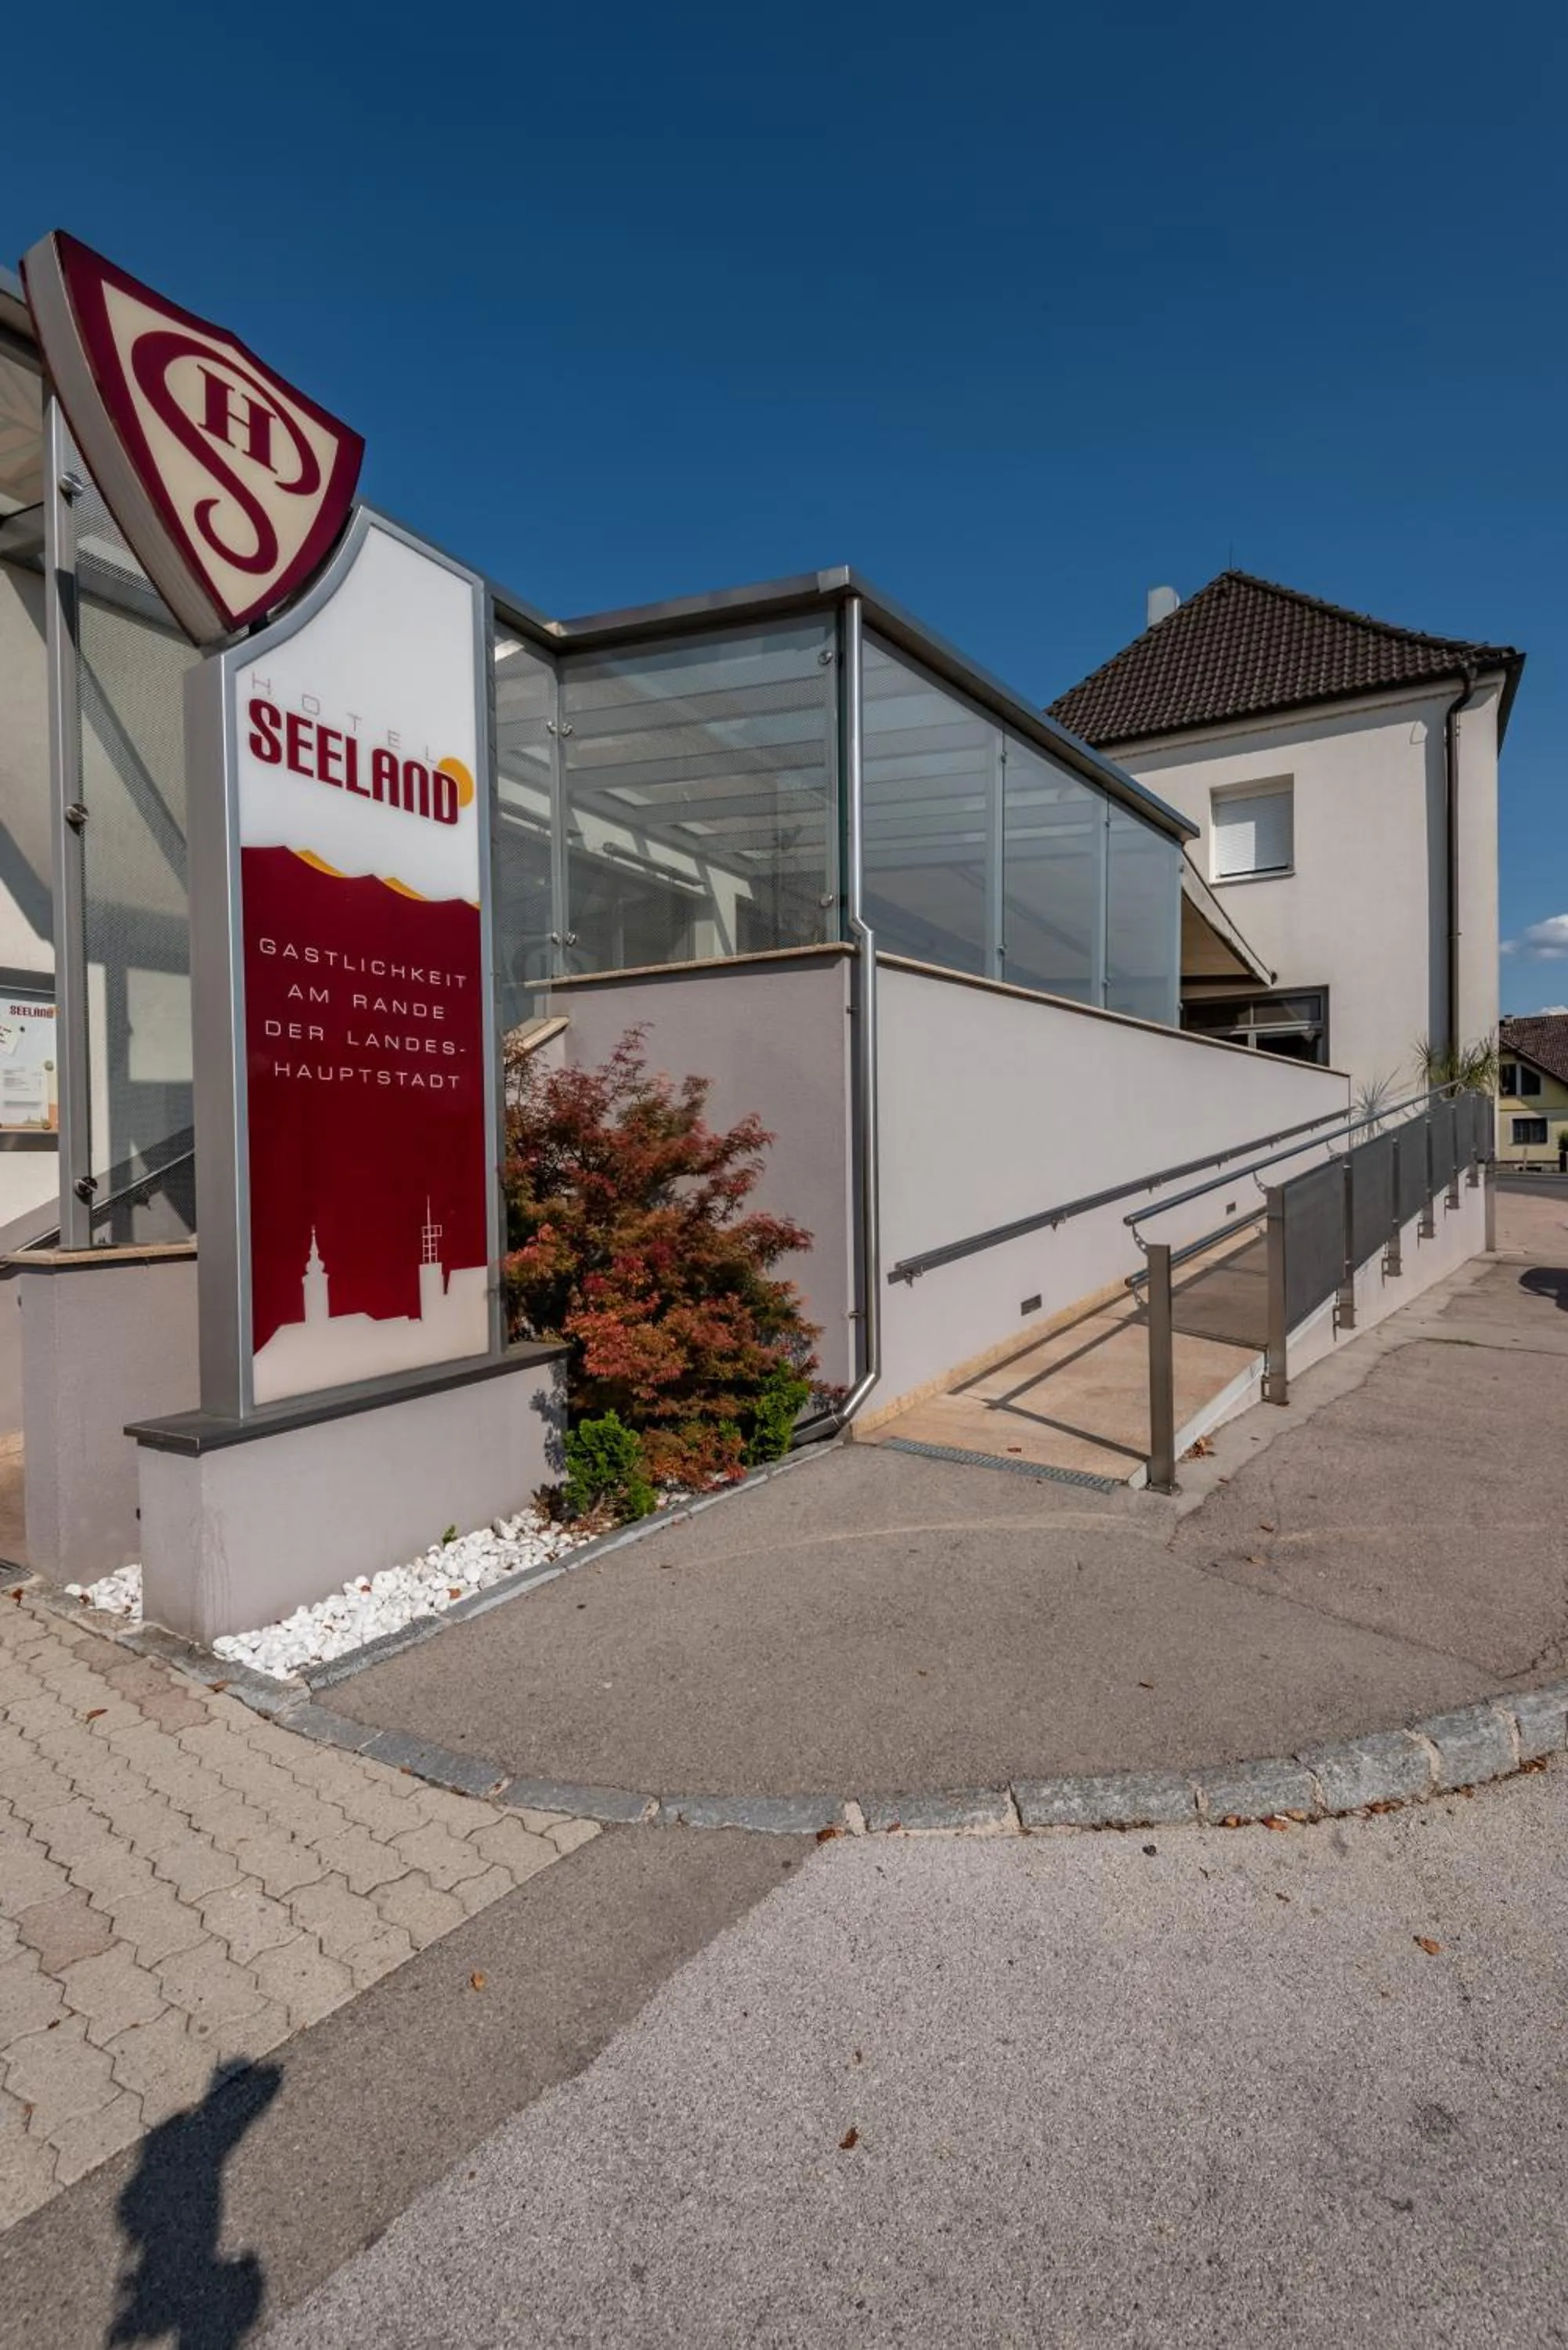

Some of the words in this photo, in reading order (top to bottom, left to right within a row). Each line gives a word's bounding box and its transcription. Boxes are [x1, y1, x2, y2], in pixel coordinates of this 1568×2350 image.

[251, 671, 437, 764] HOTEL
[248, 697, 458, 826] SEELAND
[258, 937, 468, 989] GASTLICHKEIT
[9, 1004, 55, 1019] SEELAND
[287, 983, 330, 1004] AM
[352, 993, 445, 1020] RANDE
[265, 1019, 324, 1041] DER
[347, 1030, 467, 1056] LANDES-
[274, 1061, 460, 1089] HAUPTSTADT
